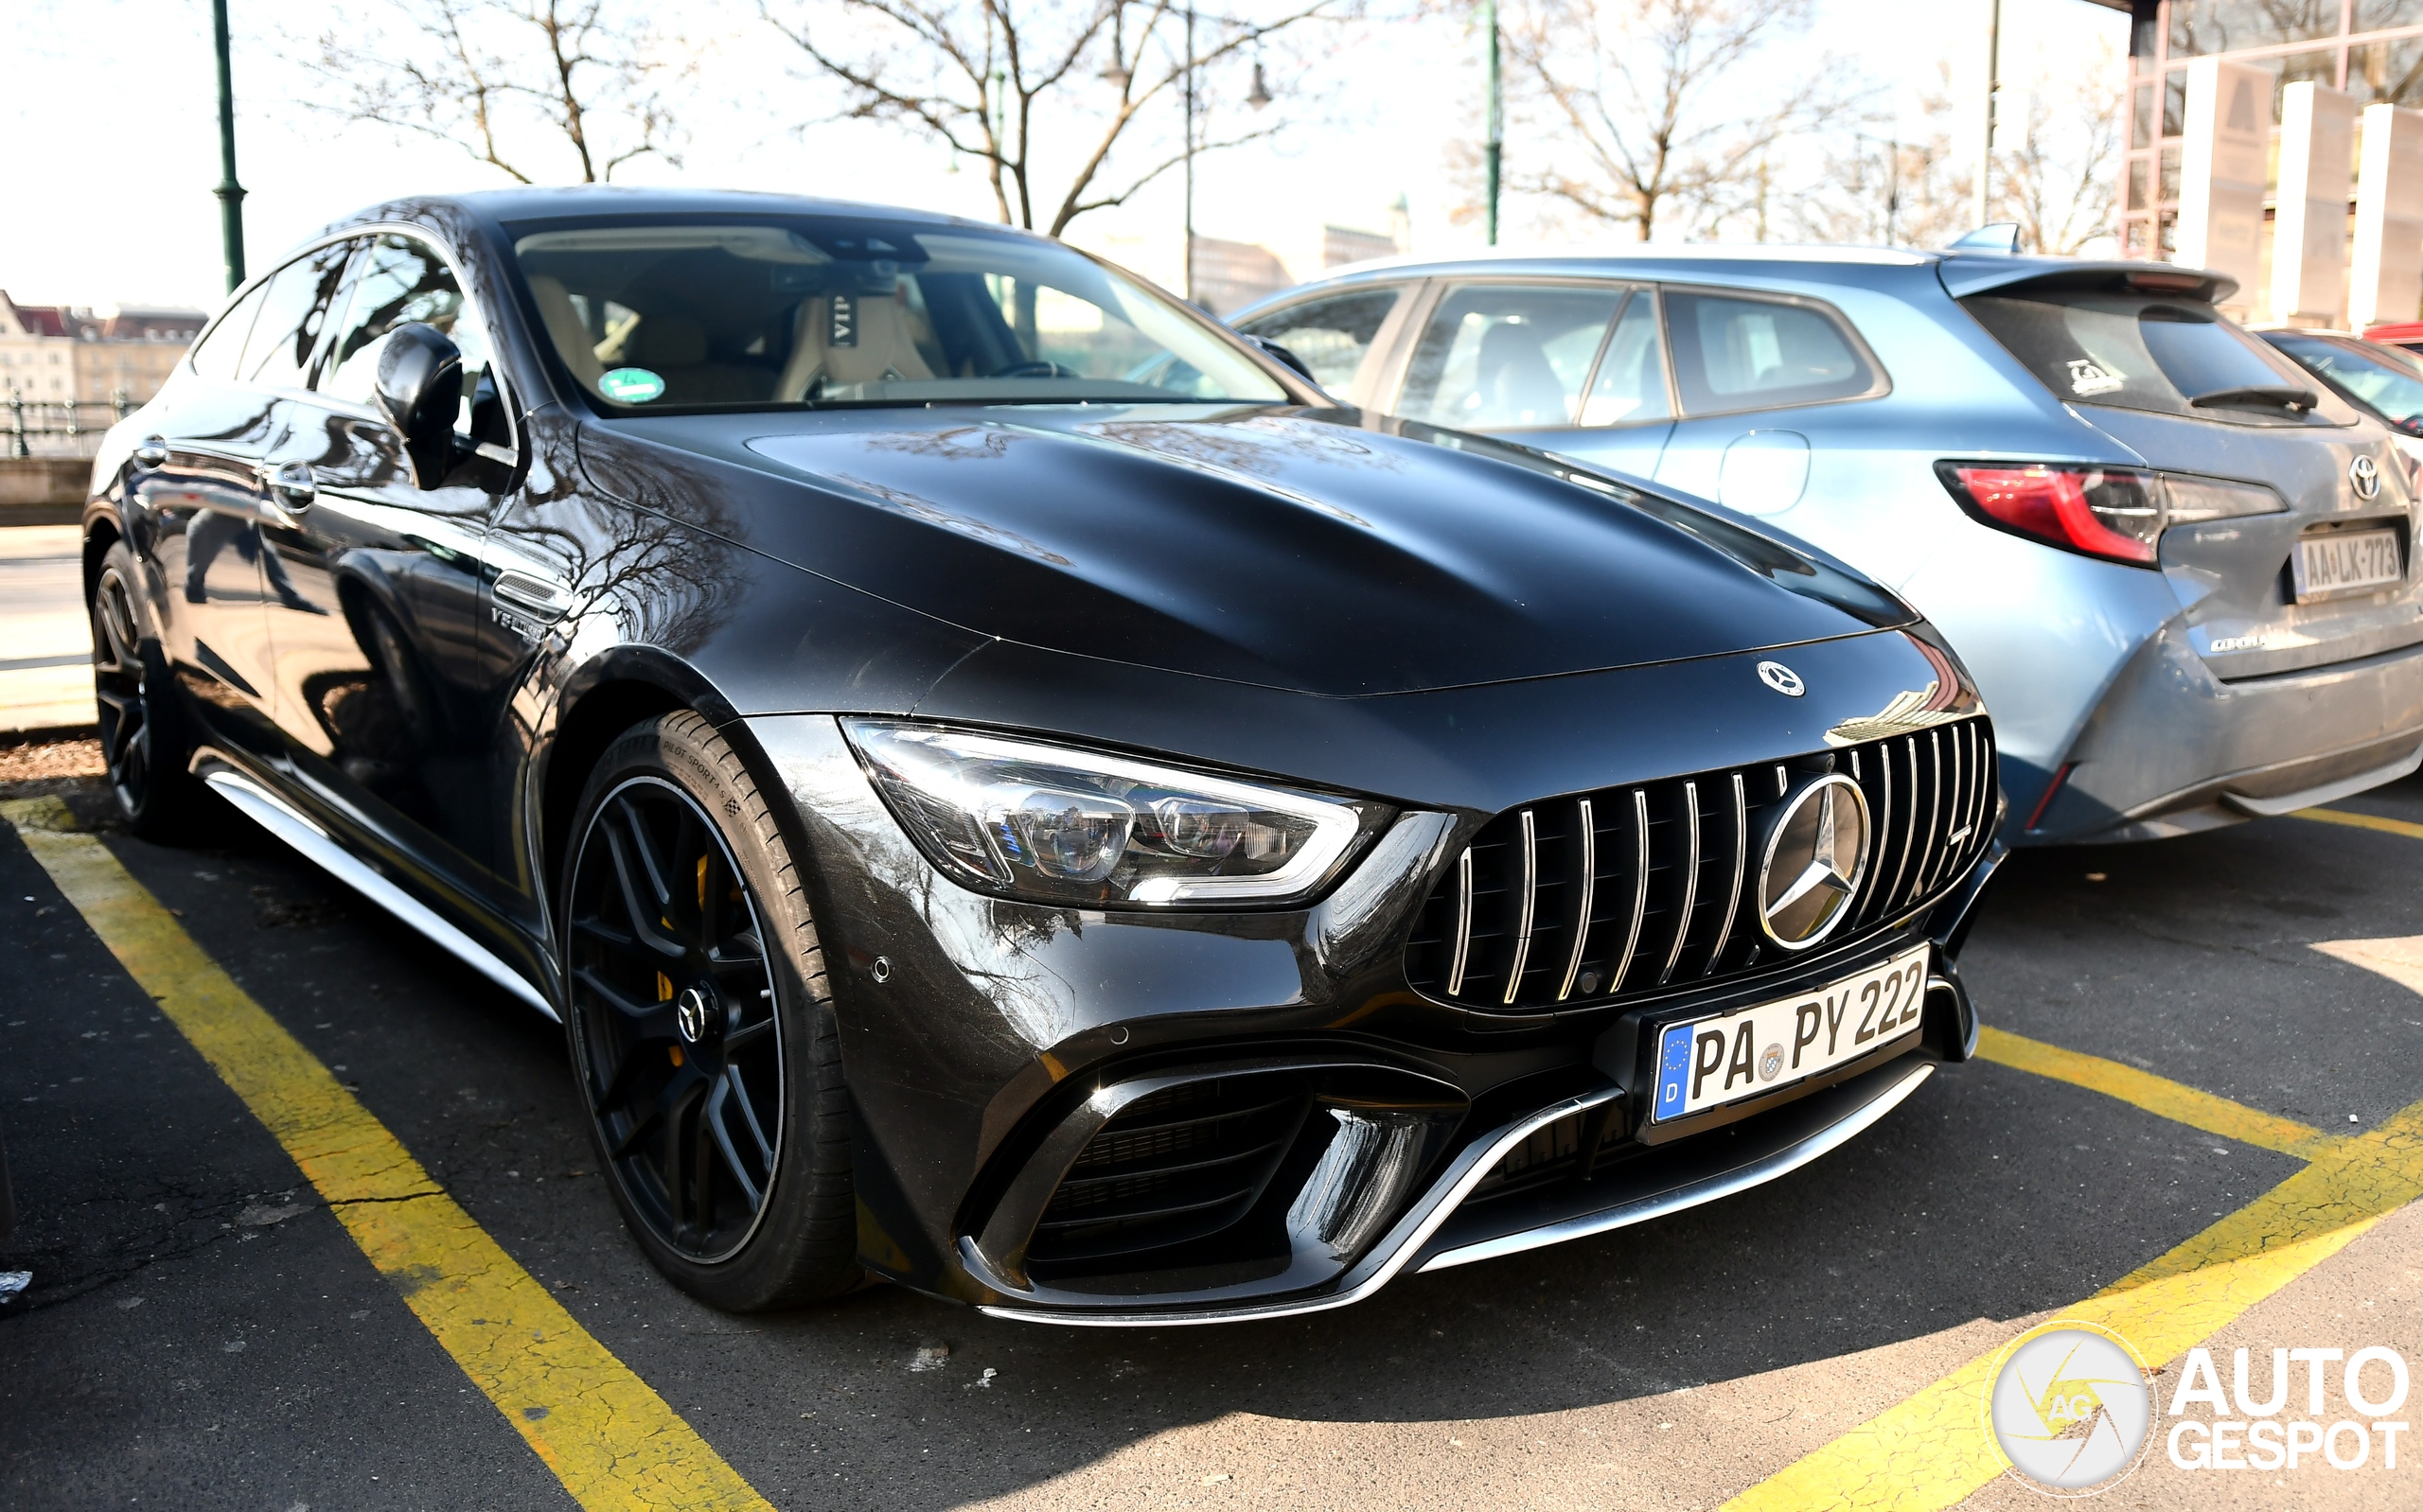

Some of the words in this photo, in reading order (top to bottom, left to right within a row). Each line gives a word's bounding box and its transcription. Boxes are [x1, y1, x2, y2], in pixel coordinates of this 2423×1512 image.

[834, 295, 851, 339] VIP
[2308, 543, 2332, 587] AA
[663, 740, 687, 759] PILOT
[687, 754, 716, 784] SPORT
[719, 789, 726, 800] S
[1691, 1020, 1754, 1099] PA
[1792, 990, 1850, 1069] PY
[1854, 960, 1922, 1046] 222
[1664, 1082, 1679, 1103] D
